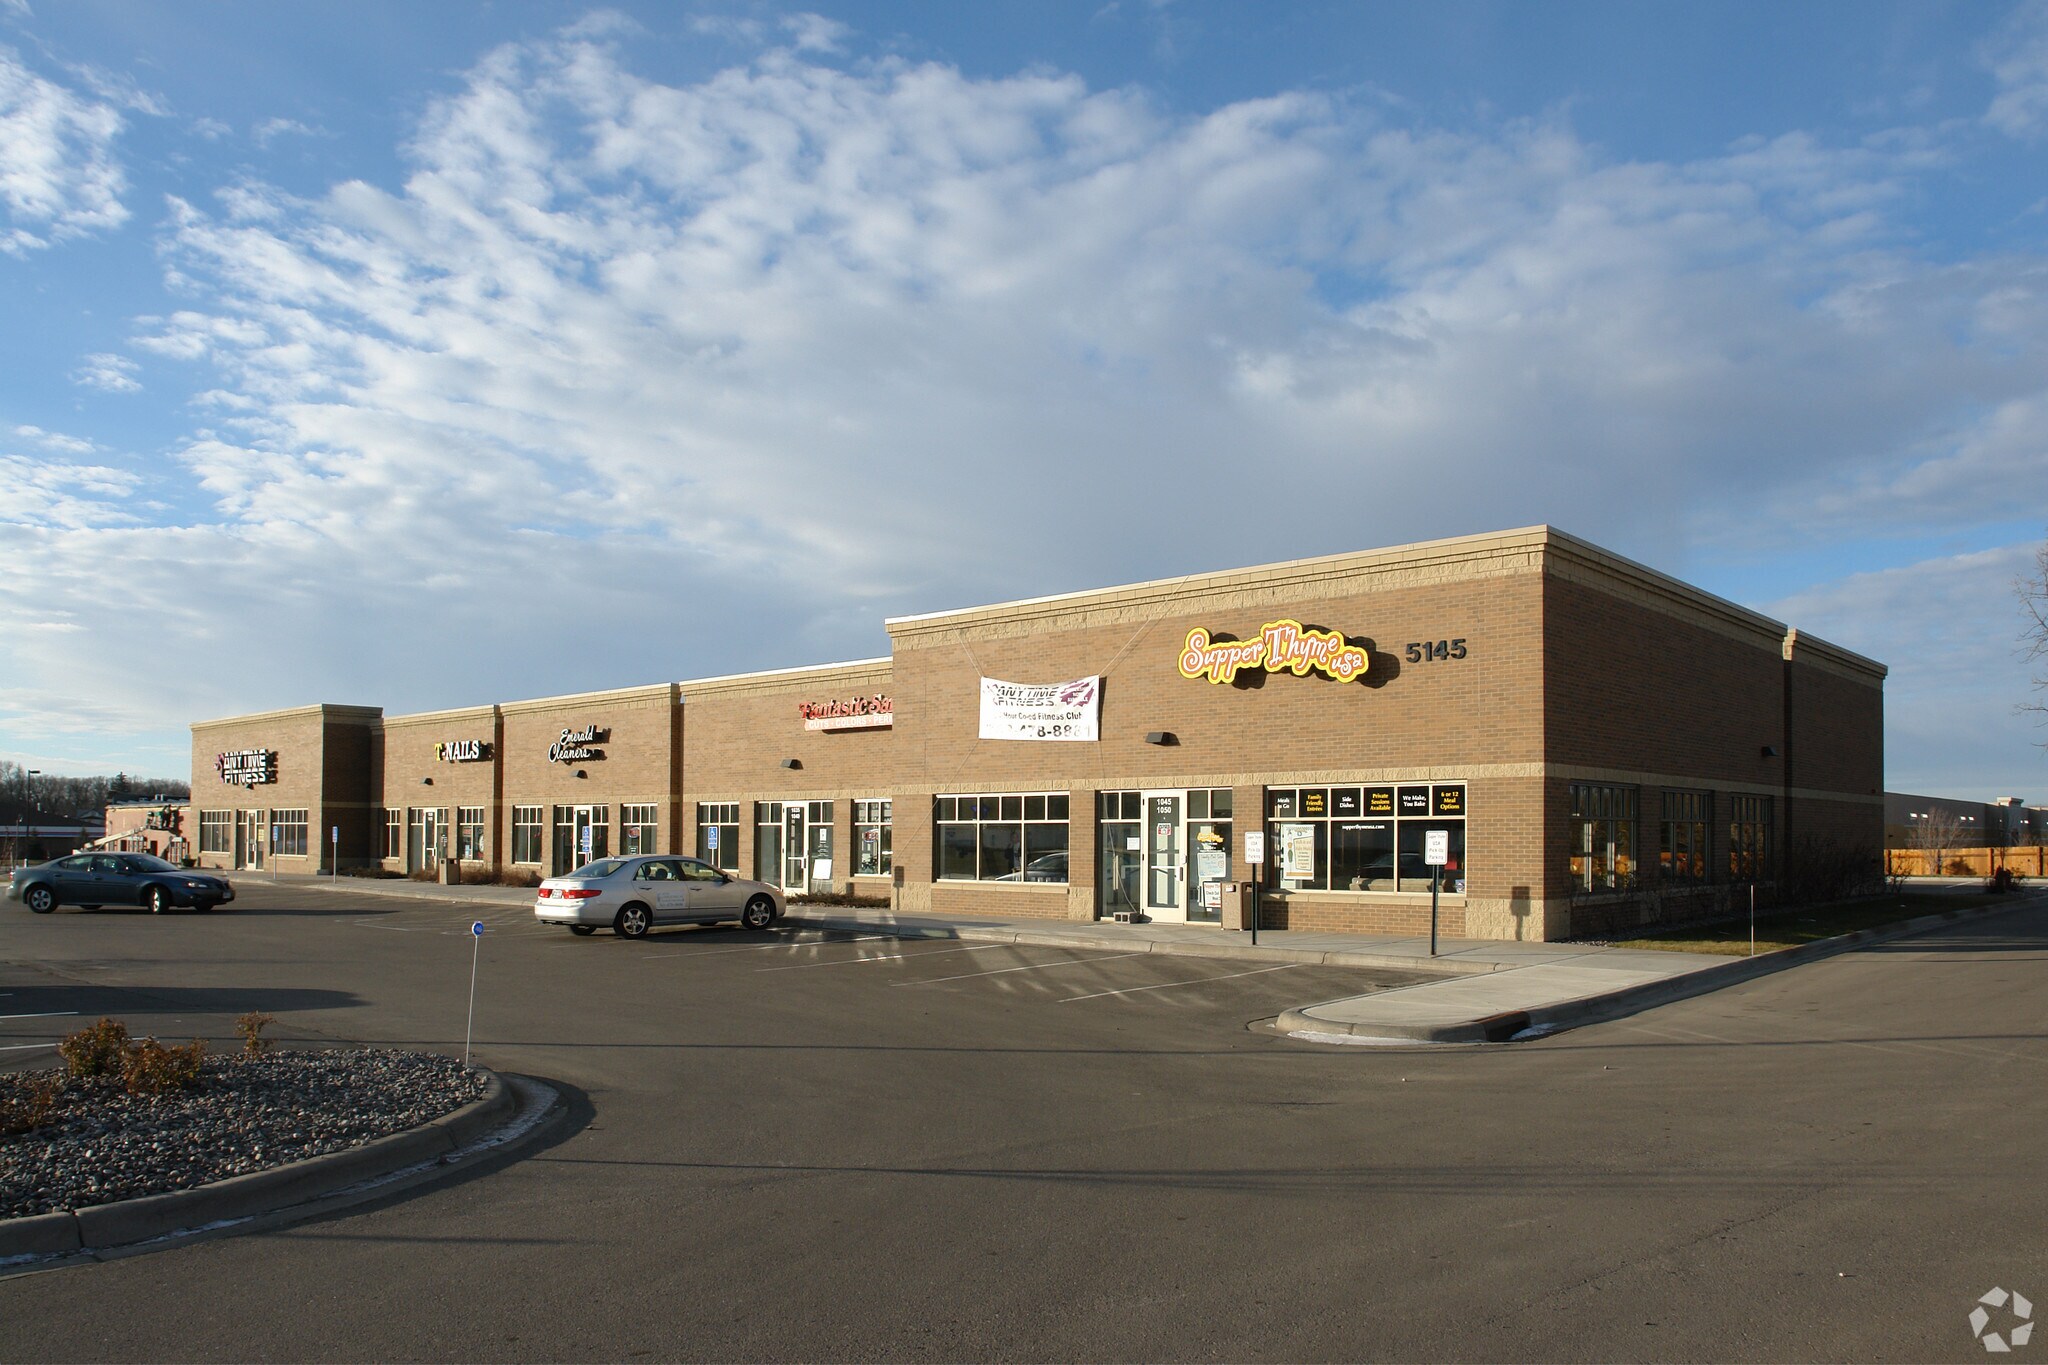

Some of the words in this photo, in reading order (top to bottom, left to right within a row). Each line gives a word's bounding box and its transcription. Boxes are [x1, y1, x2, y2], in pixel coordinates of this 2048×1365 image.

[1182, 633, 1264, 679] Supper
[1265, 626, 1339, 669] Thyme
[1405, 638, 1468, 663] 5145
[1331, 652, 1363, 676] usa
[799, 697, 868, 719] Fantastic
[808, 719, 829, 730] CUTS
[835, 716, 867, 728] COLORS
[560, 725, 594, 745] Emerald
[223, 749, 267, 769] ANYTIME
[435, 739, 480, 762] T-NAILS
[549, 743, 591, 763] Cleaners
[223, 767, 267, 784] FITNESS
[1156, 798, 1172, 806] 1045
[1156, 806, 1172, 814] 1050
